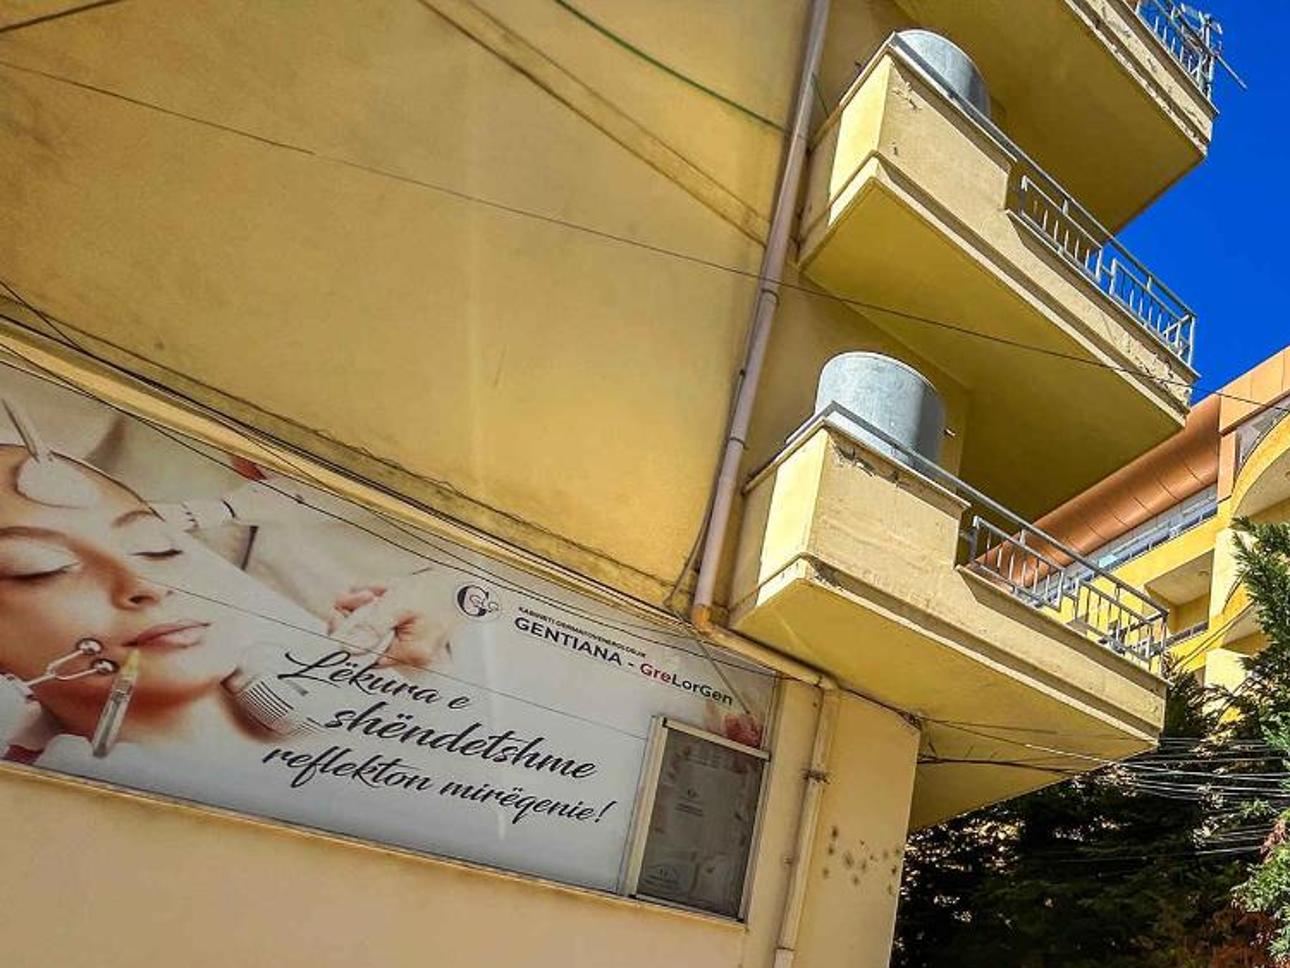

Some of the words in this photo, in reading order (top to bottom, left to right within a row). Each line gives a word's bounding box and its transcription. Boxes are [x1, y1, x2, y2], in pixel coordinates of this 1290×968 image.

[277, 650, 440, 704] Lëkura
[447, 694, 472, 710] e
[514, 617, 622, 666] GENTIANA
[640, 662, 733, 706] GreLorGen
[324, 700, 598, 779] shëndetshme
[262, 745, 433, 789] reflekton
[440, 779, 618, 825] mirëqenie!
